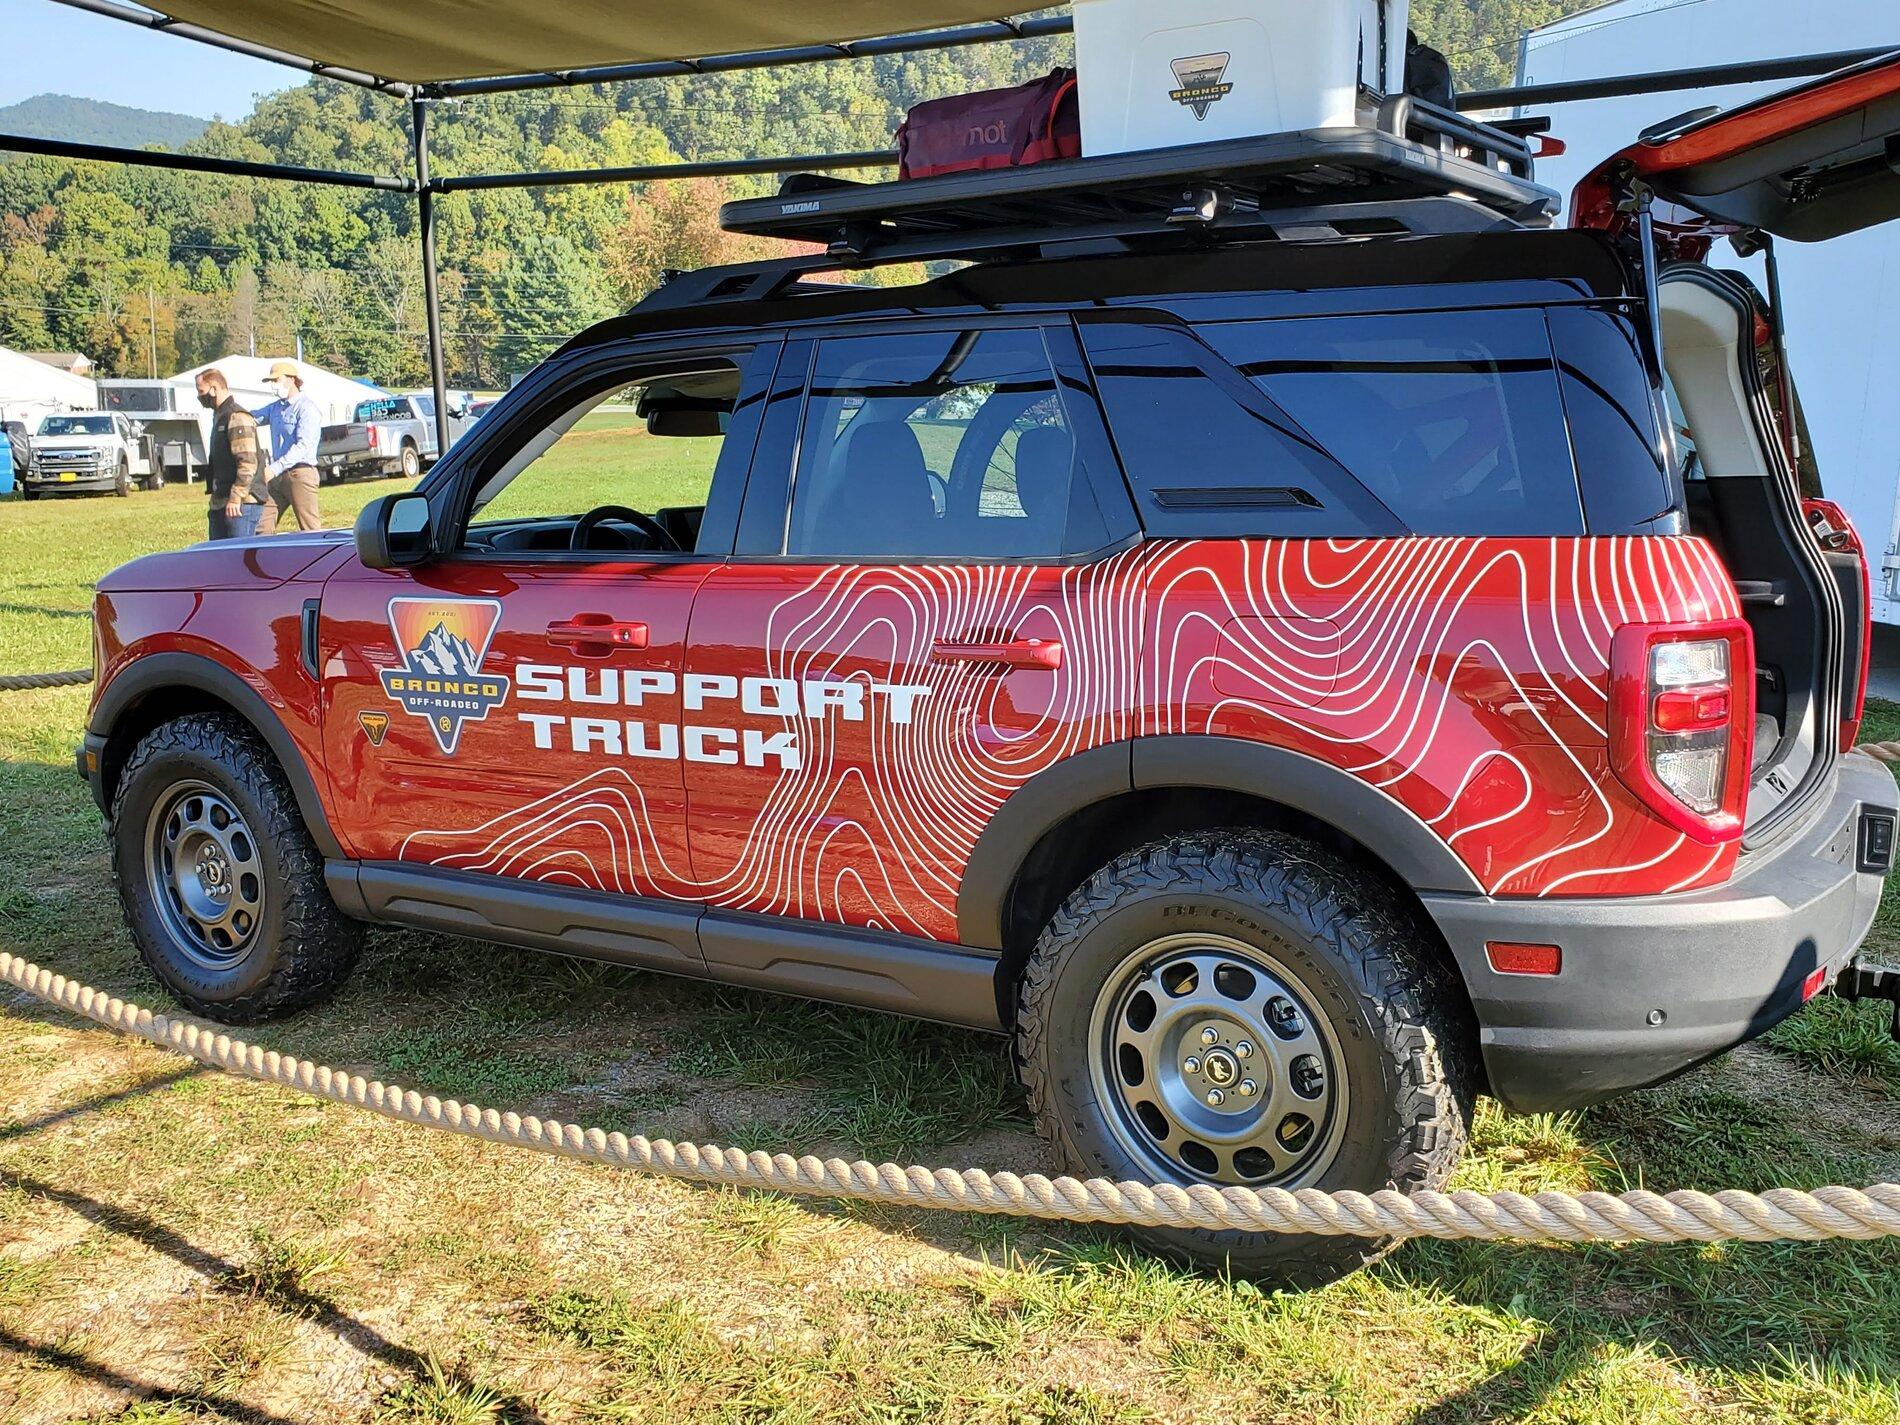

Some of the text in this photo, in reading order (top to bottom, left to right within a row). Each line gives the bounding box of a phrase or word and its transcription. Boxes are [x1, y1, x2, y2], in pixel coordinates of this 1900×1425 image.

[1172, 85, 1229, 98] BRONCO
[781, 201, 820, 215] YAKIMA
[390, 678, 499, 697] BRONCO
[515, 663, 932, 724] SUPPORT
[410, 697, 479, 710] OFF-ROADEO
[518, 713, 801, 770] TRUCK
